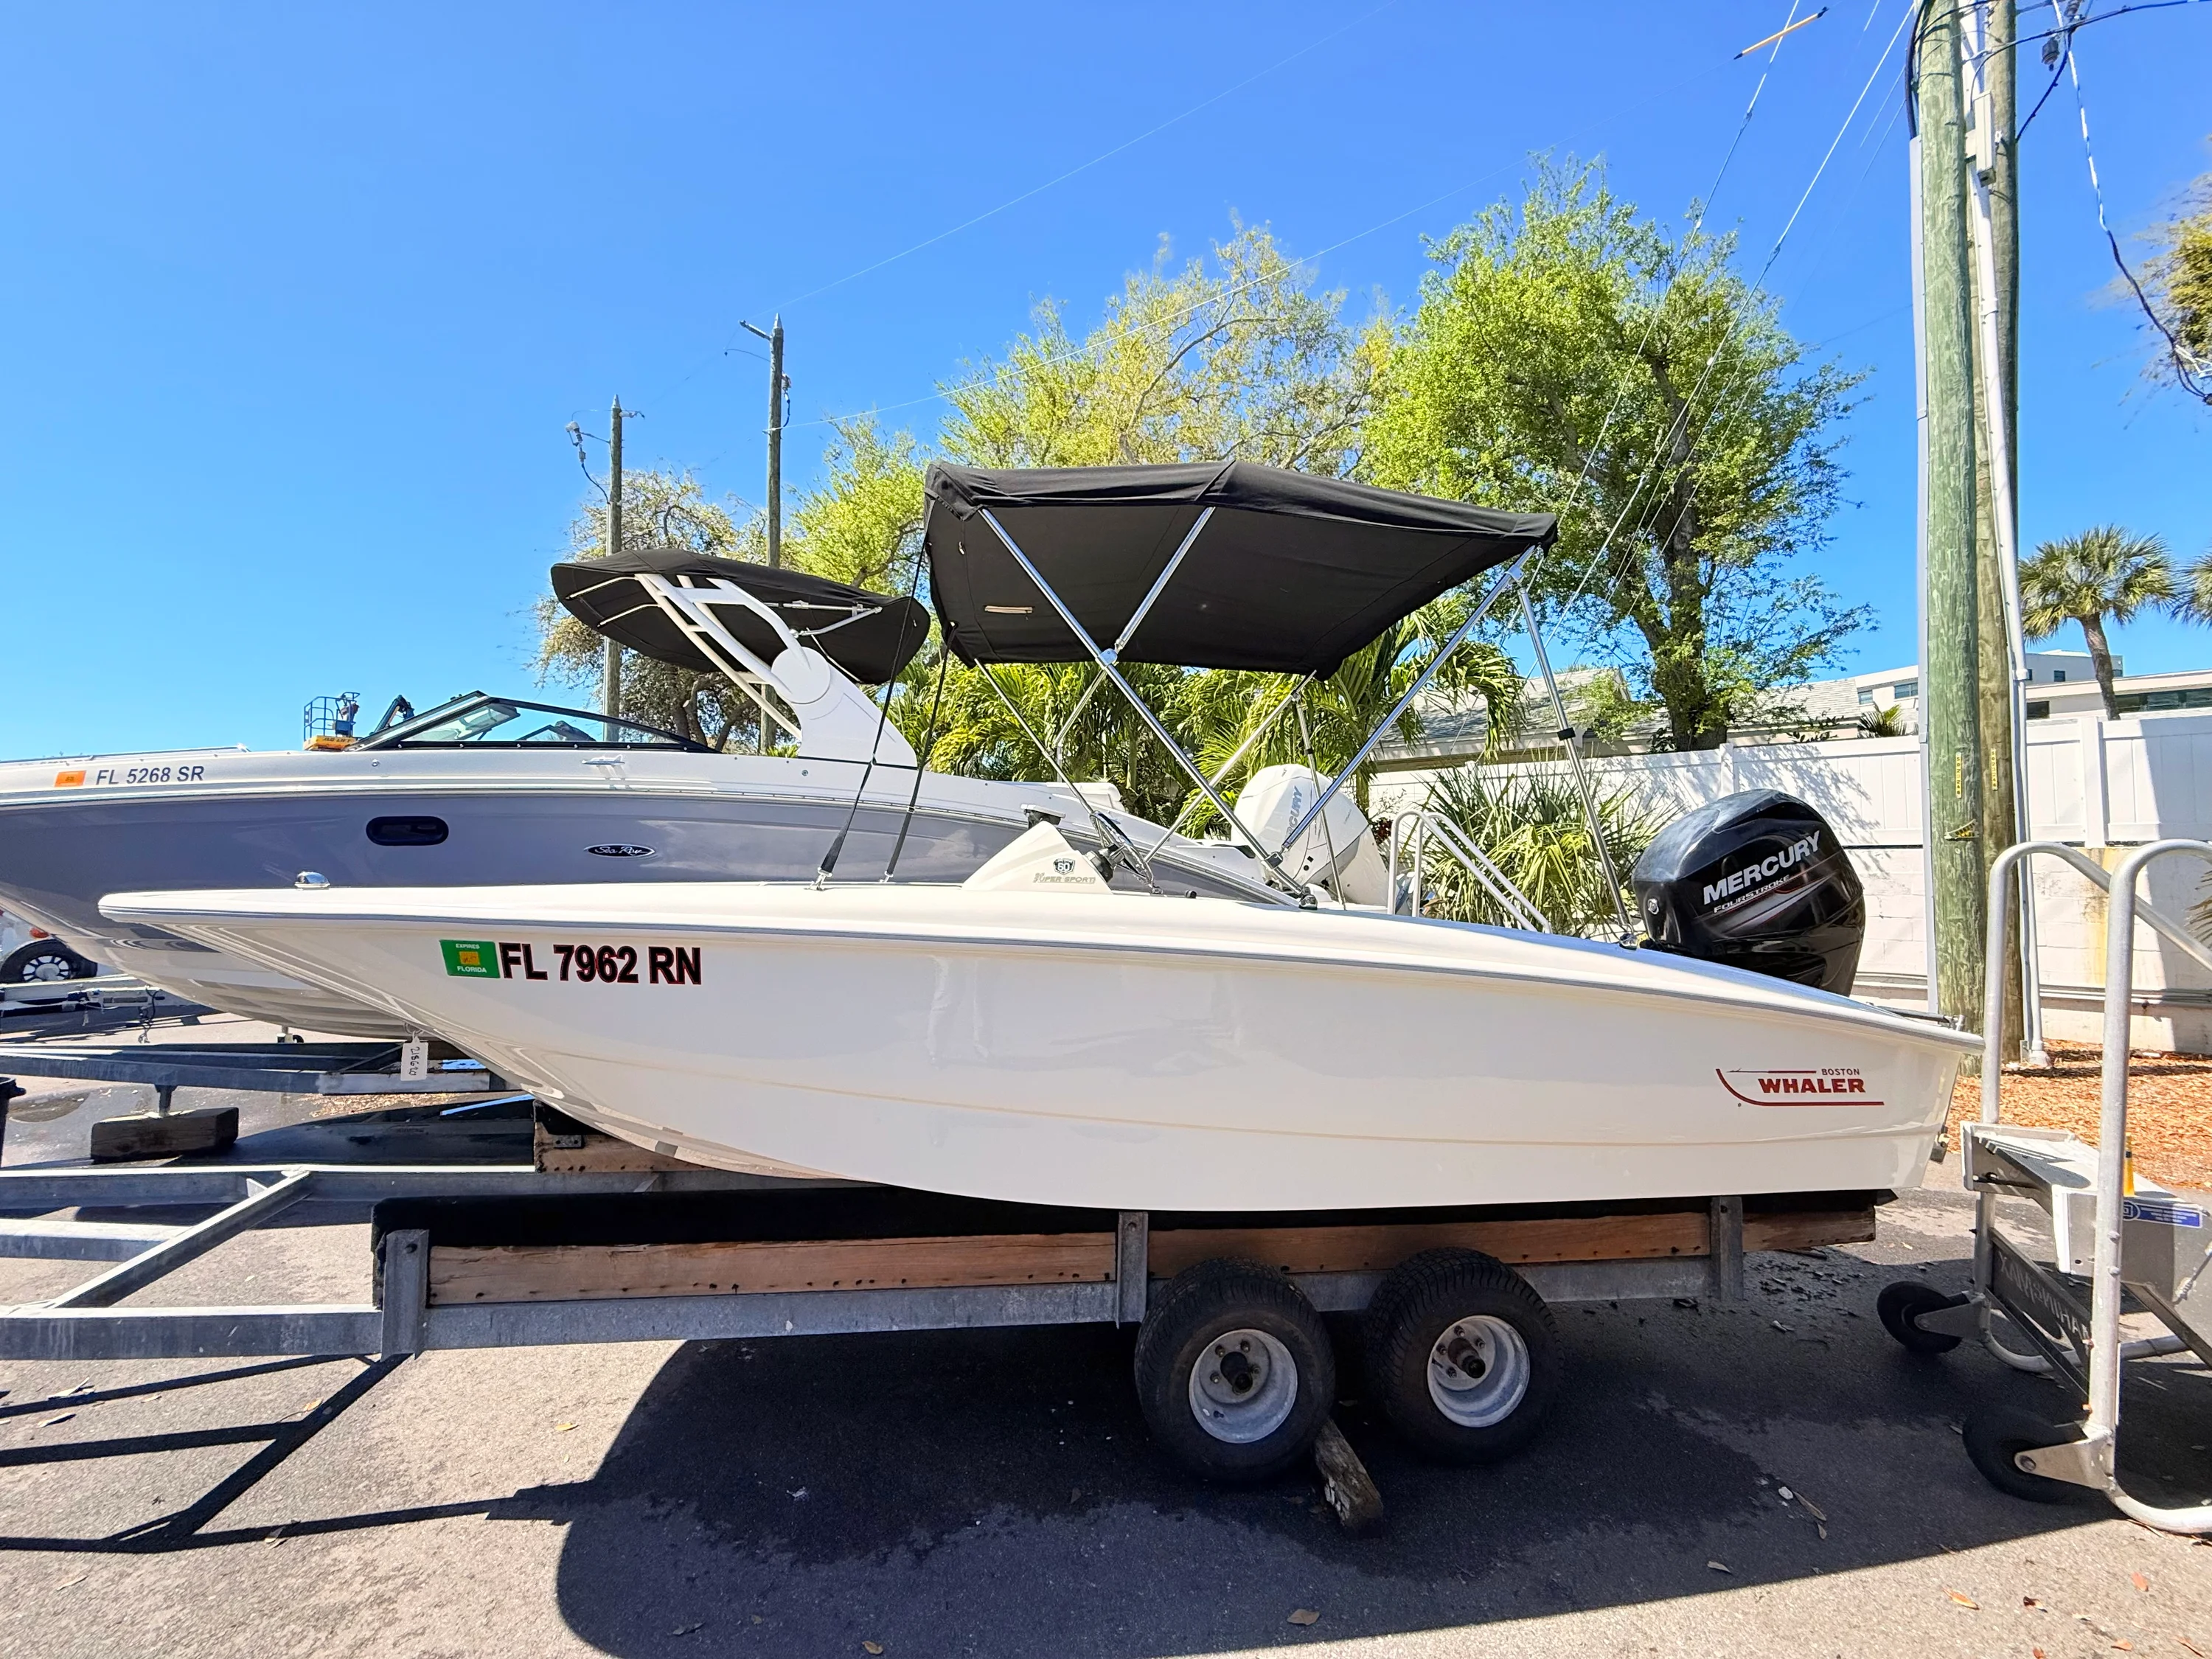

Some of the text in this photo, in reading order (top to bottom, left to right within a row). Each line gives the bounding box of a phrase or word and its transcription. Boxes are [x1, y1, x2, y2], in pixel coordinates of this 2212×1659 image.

[96, 765, 204, 785] FL 5268 SR
[1703, 830, 1820, 905] MERCURY
[1714, 874, 1790, 914] FOURSTROKE
[456, 965, 487, 973] FLORIDA
[498, 942, 702, 985] FL 7962 RN
[1821, 1068, 1860, 1077] BOSTON
[1758, 1078, 1866, 1093] WHALER
